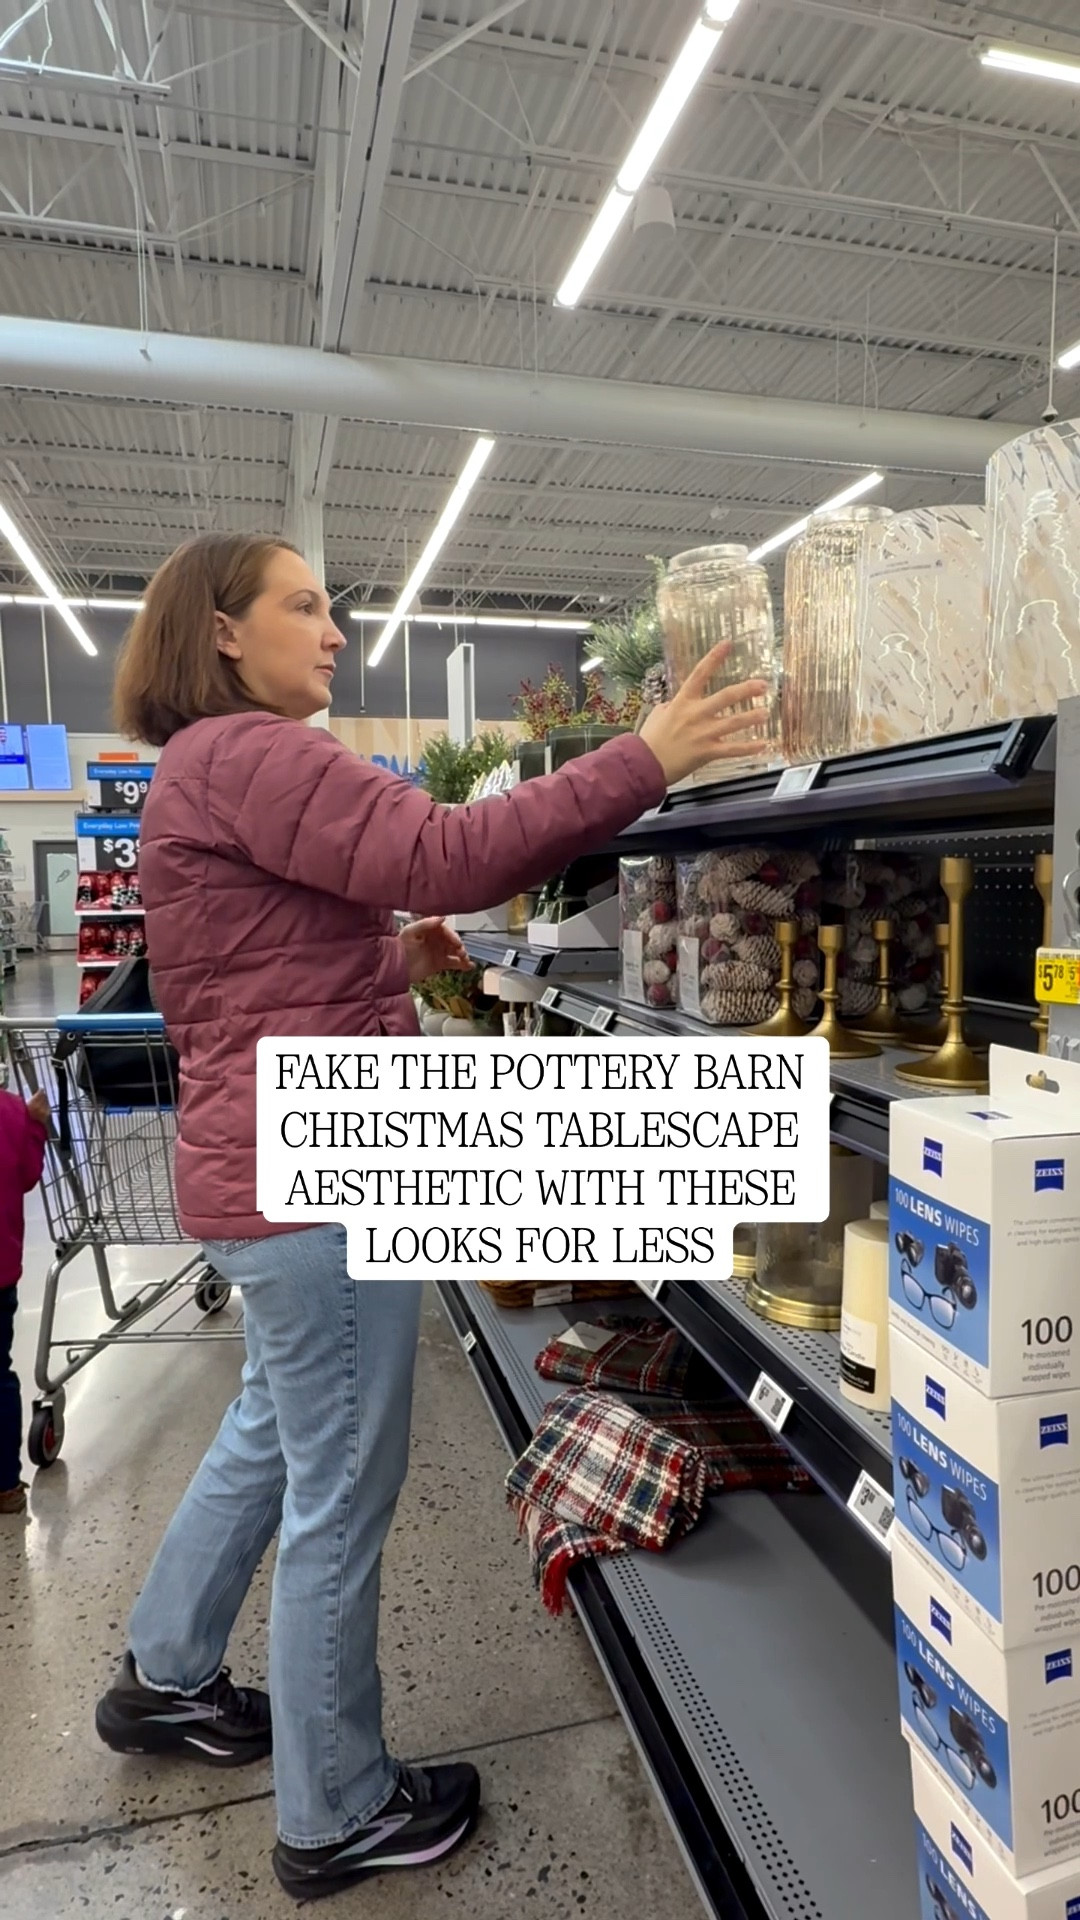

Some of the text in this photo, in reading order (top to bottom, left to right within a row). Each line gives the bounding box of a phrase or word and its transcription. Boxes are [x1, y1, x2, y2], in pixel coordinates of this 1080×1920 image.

[83, 822, 113, 830] Everyday
[1035, 1167, 1063, 1177] ZEISS
[895, 1188, 980, 1247] 100 LENS WIPES
[1021, 1315, 1073, 1346] 100
[1041, 1422, 1068, 1435] ZEISS
[897, 1412, 987, 1501] 100 LENS WIPES
[1033, 1565, 1080, 1598] 100
[902, 1620, 917, 1647] 100
[918, 1639, 955, 1691] LENS
[957, 1682, 996, 1734] WIPES
[1046, 1656, 1071, 1671] ZEISS
[940, 1859, 977, 1919] LENS
